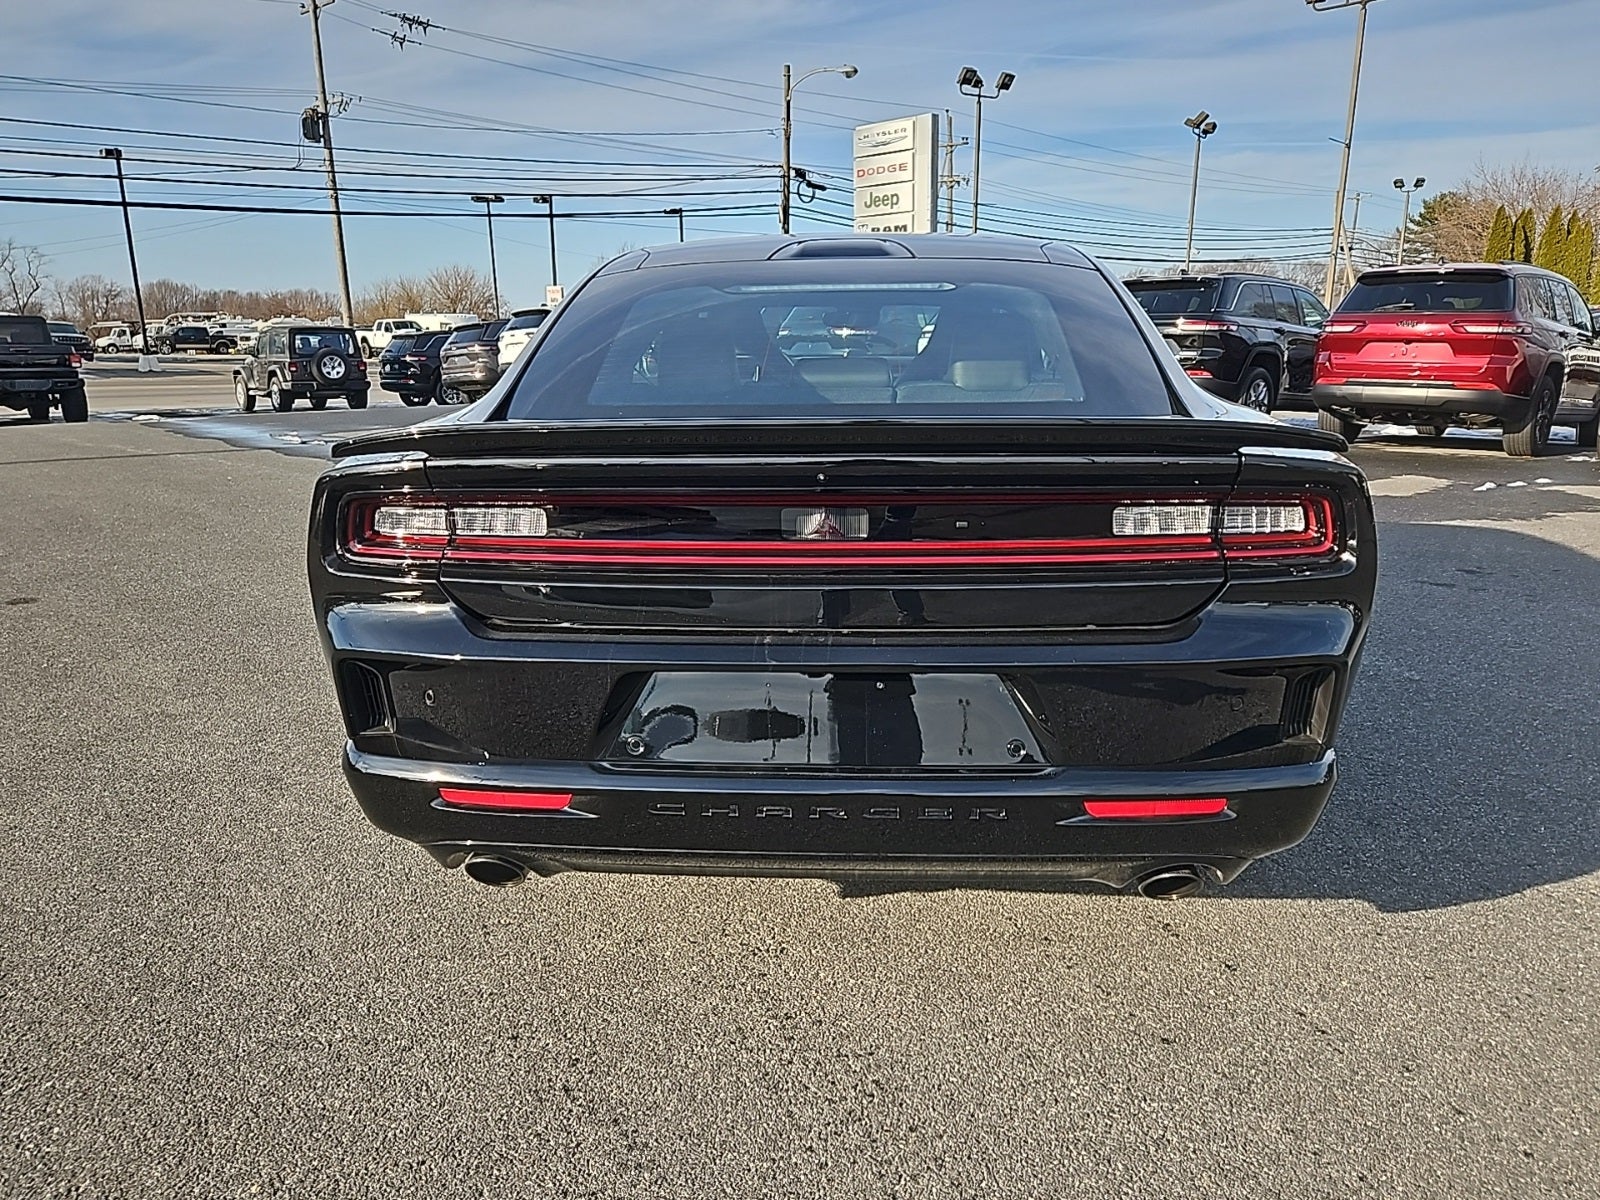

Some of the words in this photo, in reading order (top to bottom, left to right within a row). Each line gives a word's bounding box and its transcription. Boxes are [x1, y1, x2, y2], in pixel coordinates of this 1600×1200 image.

[857, 162, 908, 178] DODGE
[863, 191, 900, 210] Jeep
[647, 802, 1009, 821] CHARGER
